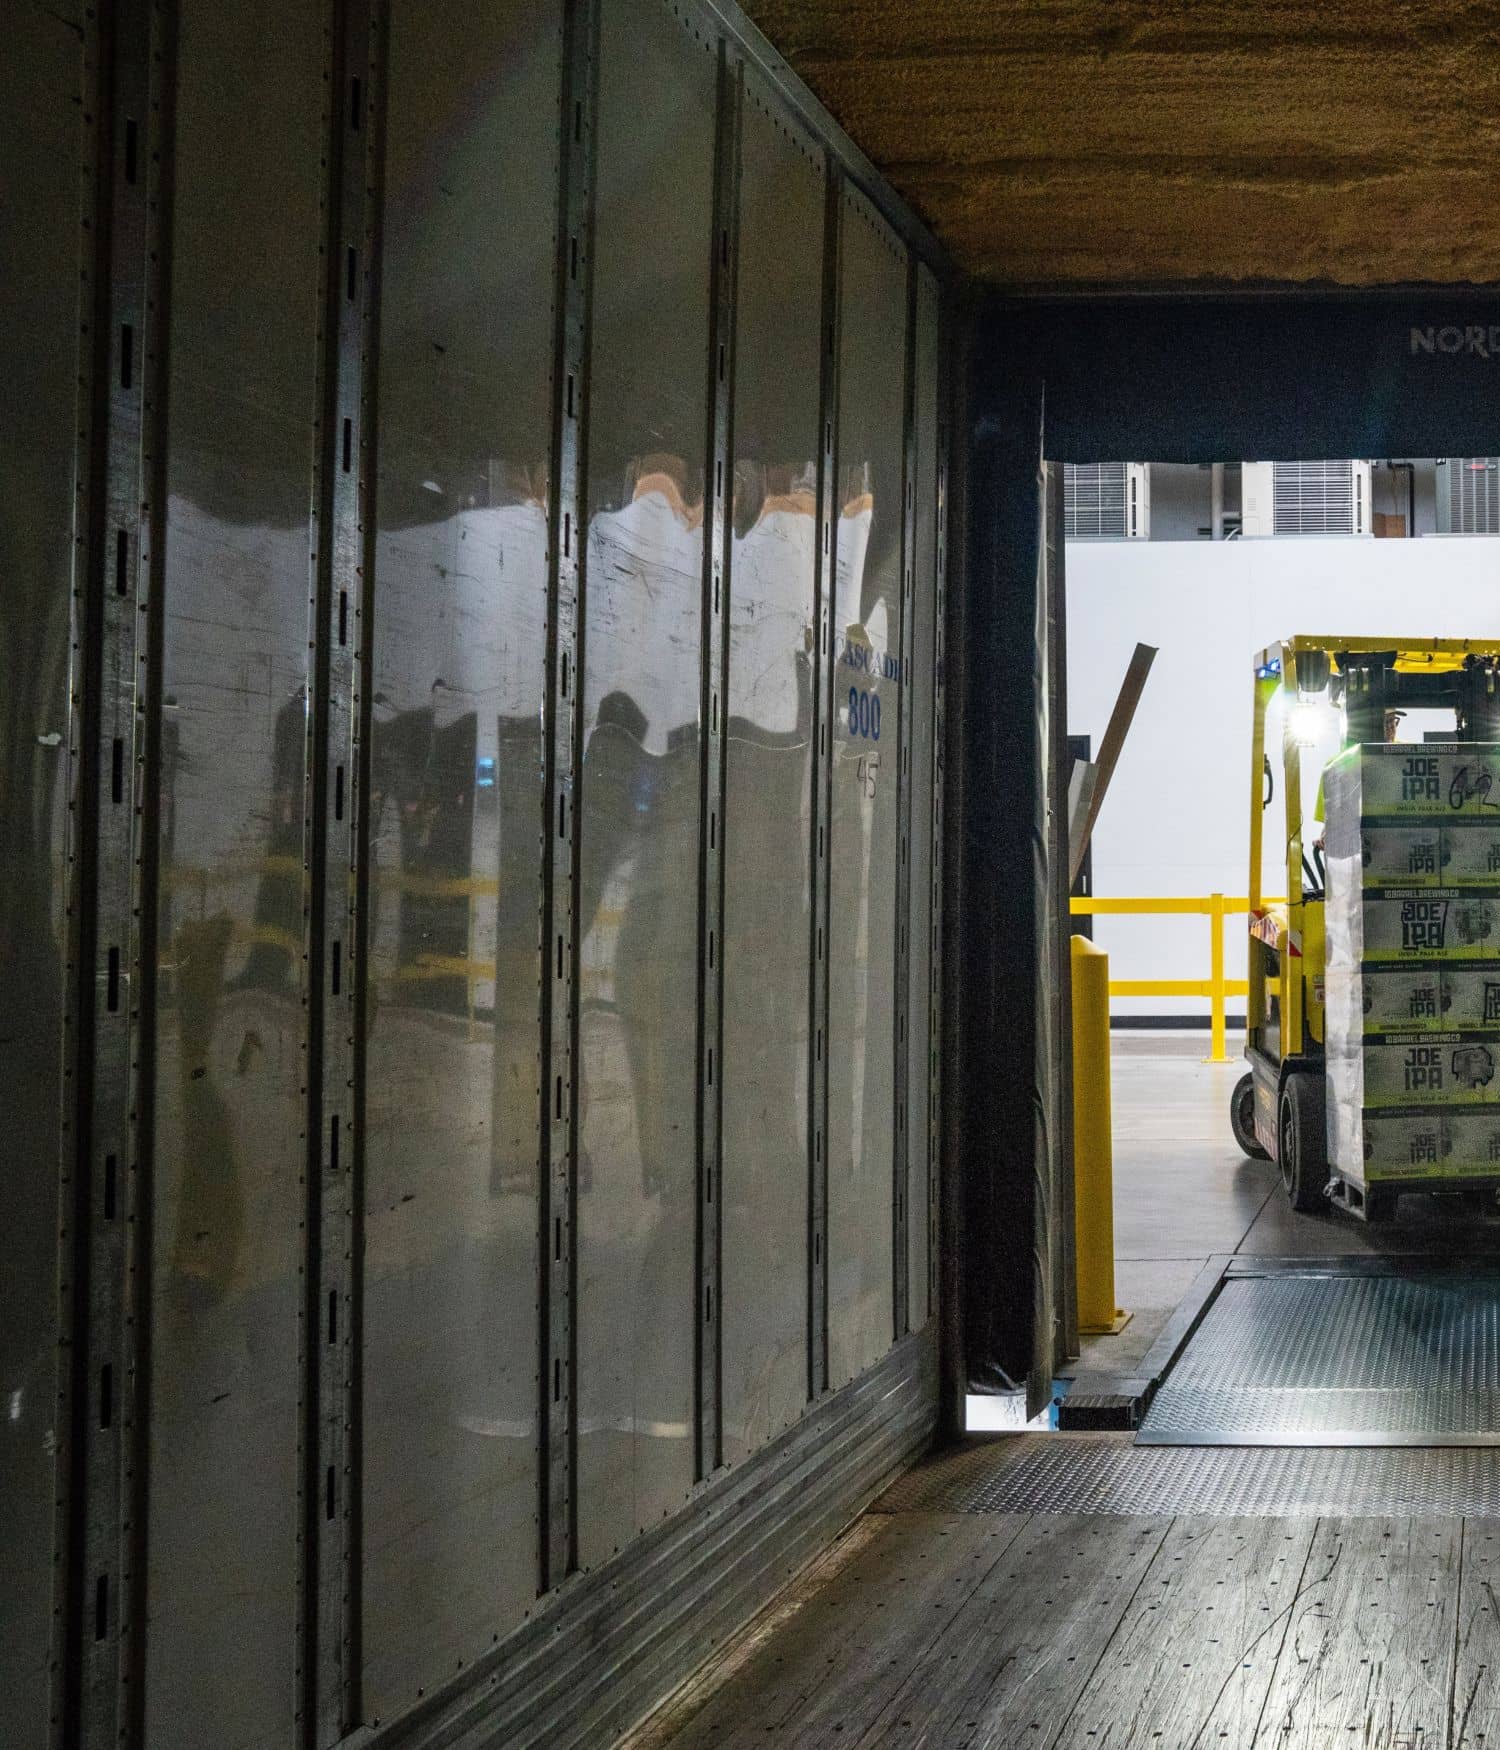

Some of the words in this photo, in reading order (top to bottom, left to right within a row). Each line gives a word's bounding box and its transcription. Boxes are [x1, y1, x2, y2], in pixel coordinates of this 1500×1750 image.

[849, 686, 881, 741] 800
[1402, 759, 1439, 776] JOE
[1402, 777, 1440, 800] IPA
[1409, 844, 1434, 856] JOE
[1408, 857, 1435, 873] IPA
[1404, 901, 1441, 921] JOE
[1403, 922, 1442, 946] IPA
[1410, 988, 1435, 1000] JOE
[1410, 1001, 1436, 1017] IPA
[1405, 1047, 1442, 1066] JOE
[1405, 1067, 1442, 1090] IPA
